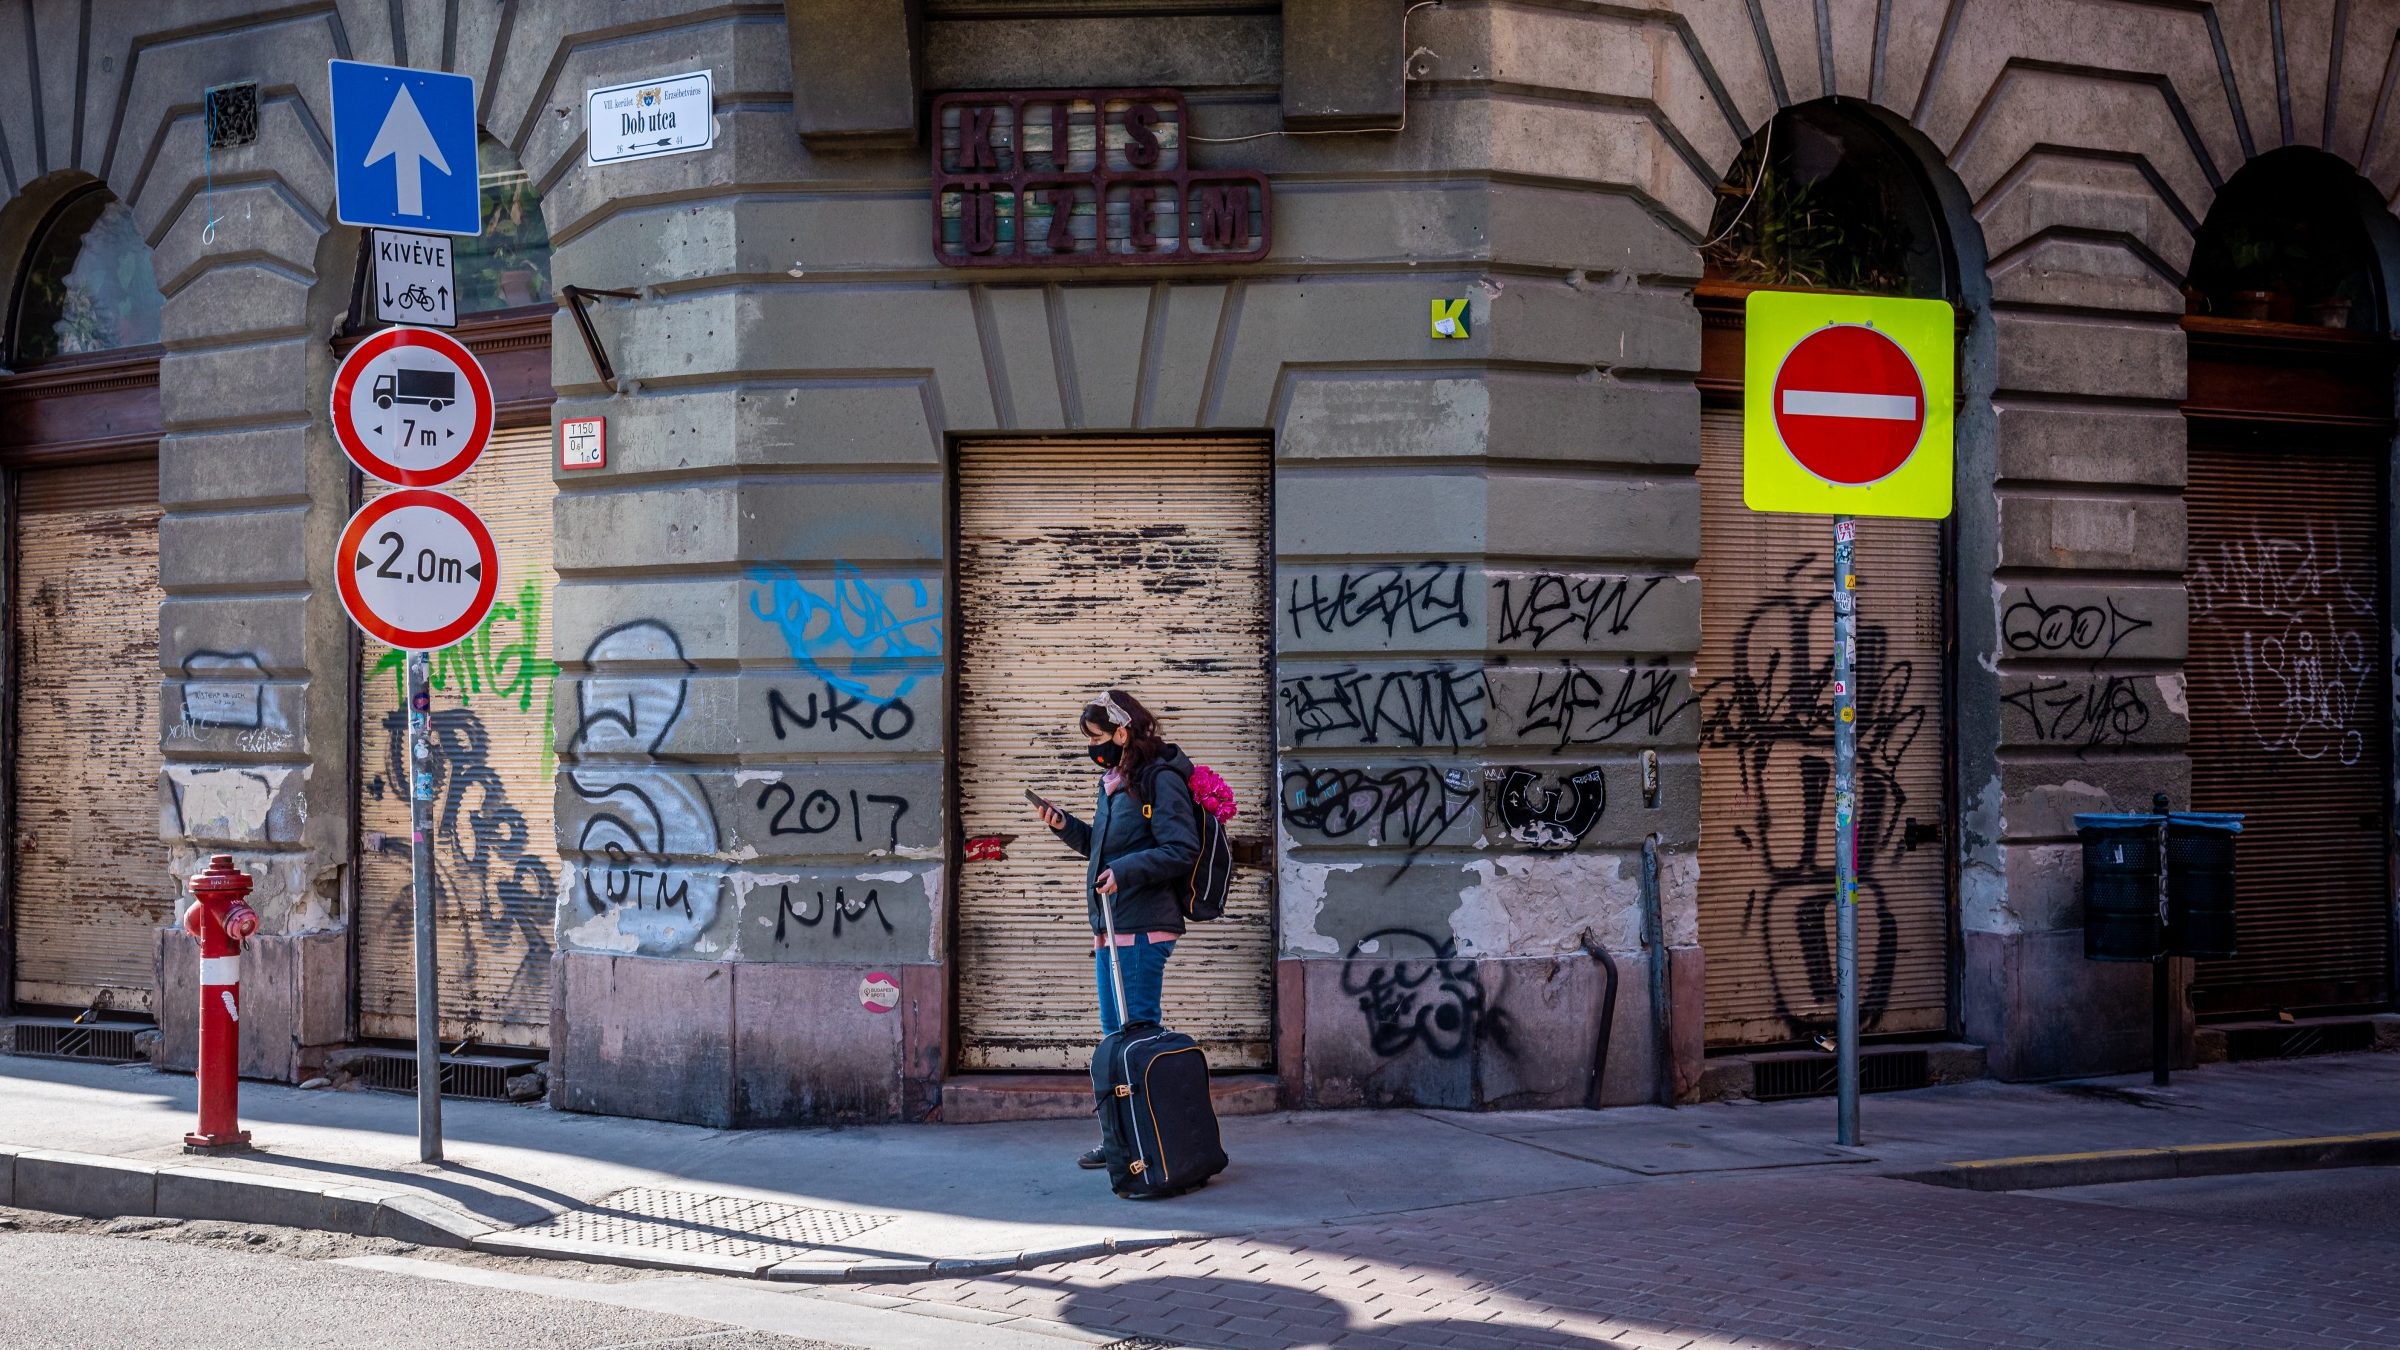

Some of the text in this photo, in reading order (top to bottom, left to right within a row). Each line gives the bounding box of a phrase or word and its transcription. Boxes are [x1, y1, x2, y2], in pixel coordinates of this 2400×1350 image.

[615, 97, 634, 108] kerület
[664, 86, 701, 100] Erzsébetváros
[621, 108, 677, 136] Dob utca
[959, 103, 1160, 169] KIS
[960, 182, 1249, 253] ÜZEM
[380, 240, 446, 268] KIVÉVE
[376, 531, 462, 584] 2.0m
[767, 682, 915, 740] NKO
[757, 780, 909, 854] 2017
[775, 884, 894, 940] NM
